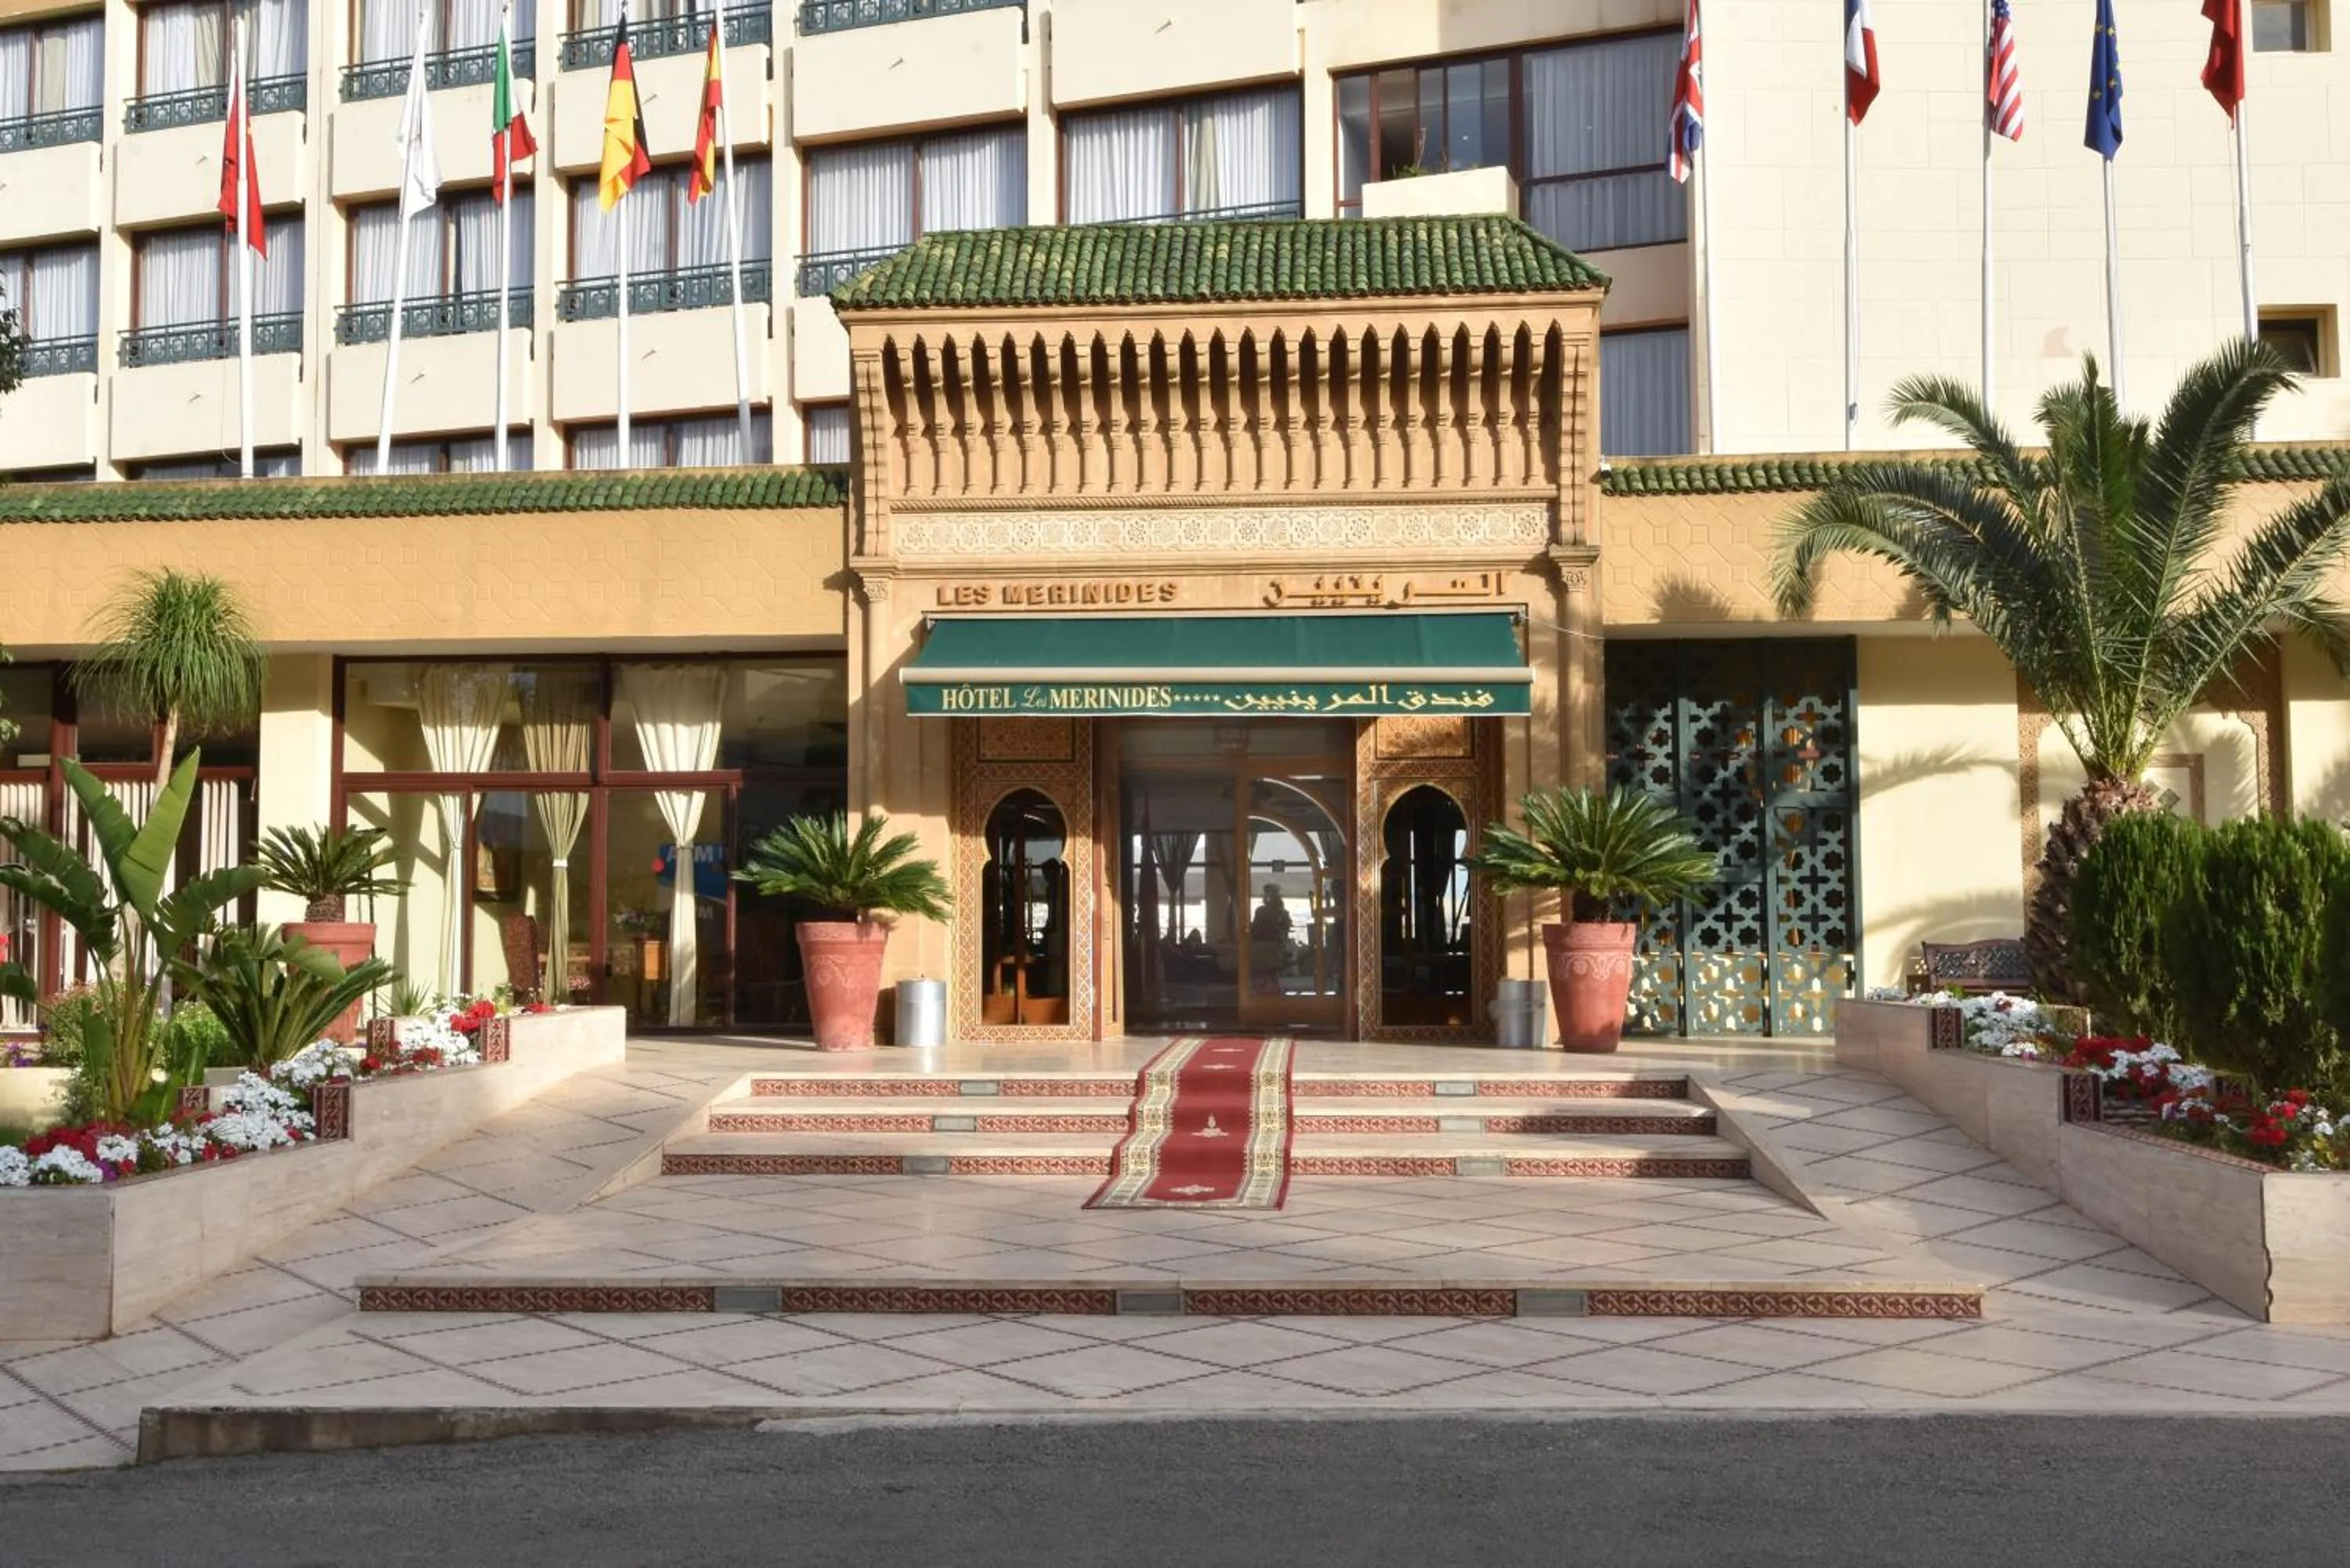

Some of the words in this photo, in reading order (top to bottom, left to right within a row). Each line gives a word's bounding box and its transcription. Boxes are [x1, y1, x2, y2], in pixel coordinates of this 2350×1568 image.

[936, 586, 991, 605] LES
[1002, 582, 1177, 605] MERINIDES
[942, 684, 1016, 710] HÔTEL
[1049, 686, 1173, 709] MERINIDES
[1397, 689, 1495, 710] فندق
